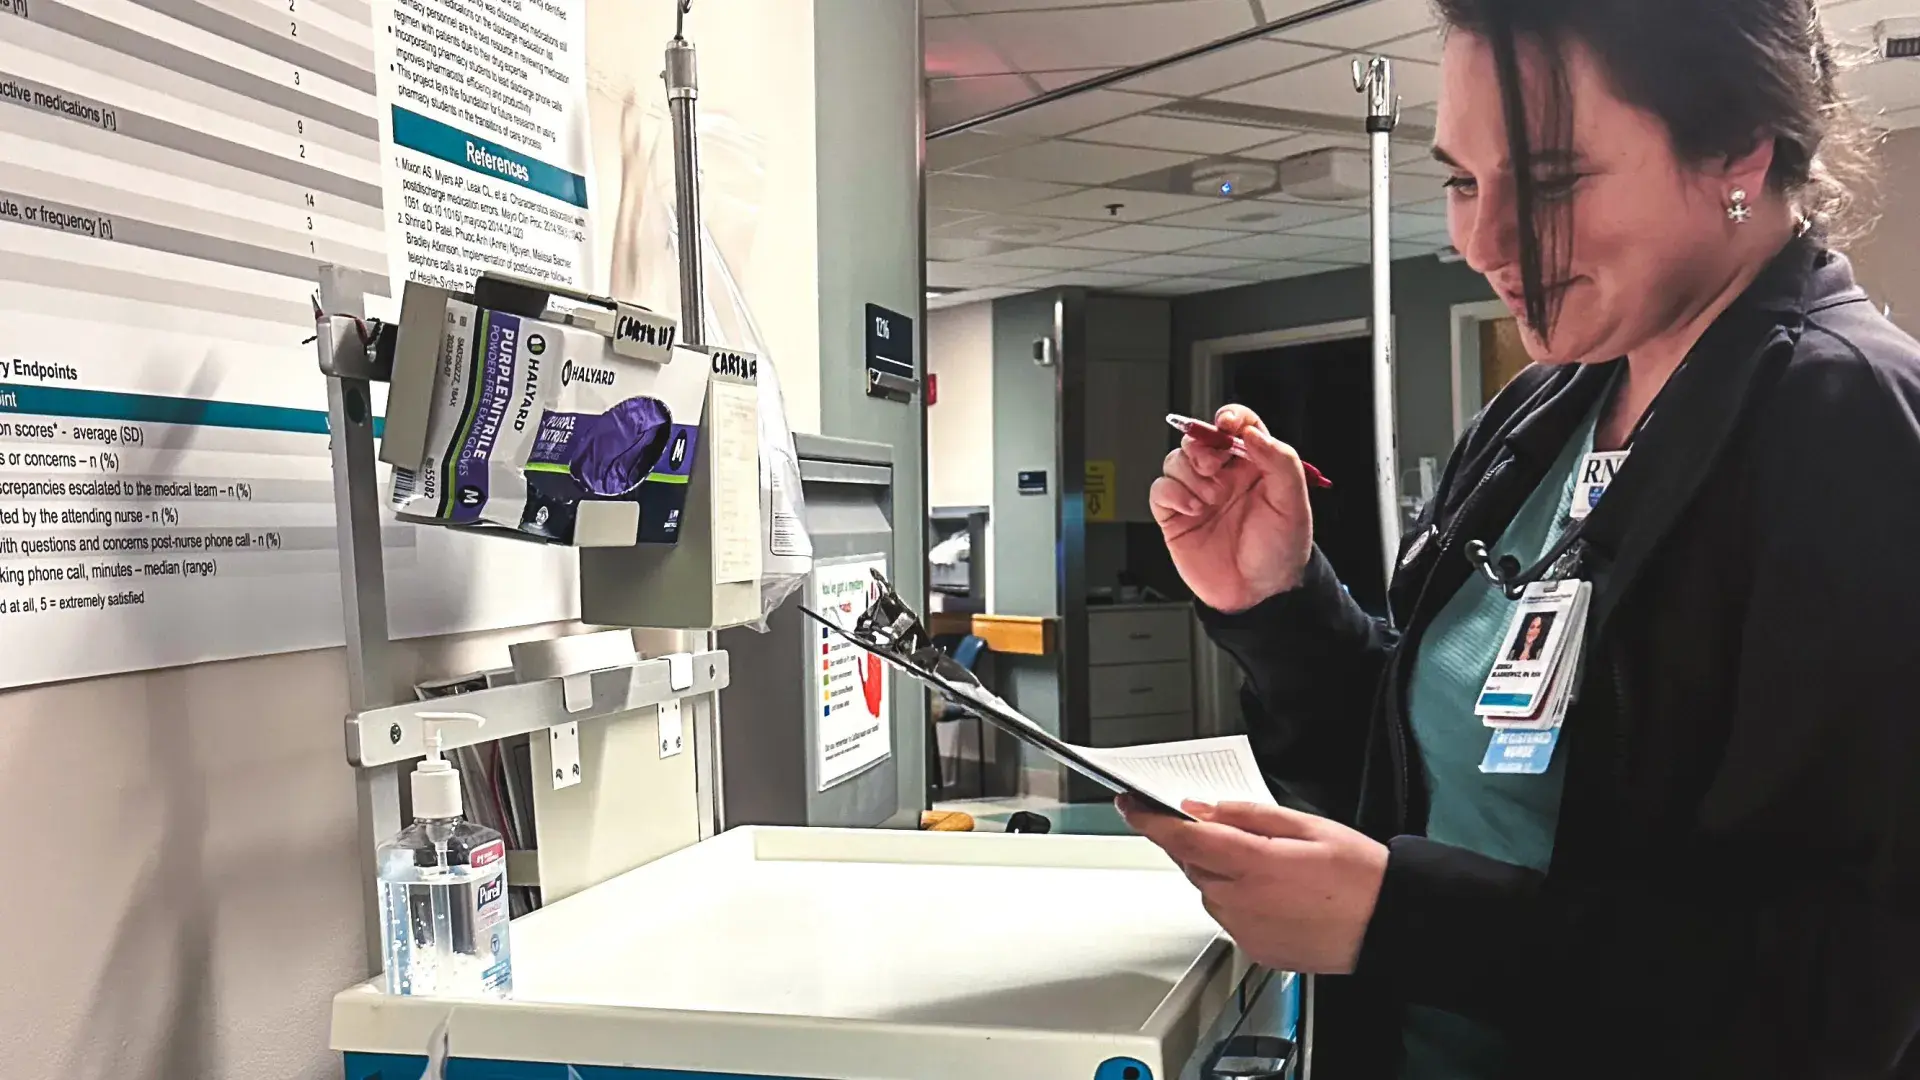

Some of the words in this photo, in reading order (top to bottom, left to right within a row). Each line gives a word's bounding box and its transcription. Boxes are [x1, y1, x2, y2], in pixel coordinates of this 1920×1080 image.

[289, 0, 295, 12] 2
[291, 23, 296, 36] 2
[394, 9, 420, 28] regimen
[421, 22, 435, 36] with
[436, 29, 460, 48] patients
[395, 26, 436, 58] Incorporating
[438, 46, 468, 70] pharmacy
[294, 72, 300, 85] 3
[397, 62, 412, 80] This
[412, 72, 435, 90] project
[435, 80, 448, 96] lays
[34, 92, 100, 122] medications
[103, 108, 116, 130] [n]
[398, 84, 430, 108] pharmacy
[430, 97, 458, 116] students
[464, 108, 474, 123] the
[298, 120, 303, 134] 9
[300, 144, 305, 158] 2
[466, 140, 530, 182] References
[435, 169, 454, 186] Myers
[466, 180, 481, 194] Leak
[305, 192, 315, 207] 14
[402, 178, 446, 203] postdischarge
[500, 207, 517, 222] Mayo
[25, 206, 37, 220] or
[40, 206, 96, 235] frequency
[99, 218, 113, 239] [n]
[307, 218, 313, 230] 3
[310, 241, 314, 254] 1
[406, 232, 430, 252] Bradley
[462, 246, 506, 266] Implementation
[408, 251, 439, 269] telephone
[616, 316, 647, 342] CART
[14, 359, 78, 381] Endpoints
[482, 324, 500, 406] POWDER-FREE
[496, 328, 514, 396] PURPLE
[712, 352, 740, 377] CART
[572, 366, 615, 386] HALYARD
[514, 358, 540, 431] HALYARD
[472, 407, 488, 435] EXAM
[474, 396, 506, 460] NITRILE
[546, 416, 576, 430] PURPLE
[73, 427, 118, 444] average
[120, 426, 144, 446] (SD)
[542, 429, 572, 443] NITRILE
[8, 453, 20, 466] or
[24, 454, 76, 468] concerns
[90, 456, 96, 468] n
[100, 453, 119, 472] (%)
[458, 436, 476, 476] GLOVES
[672, 439, 686, 462] M
[1582, 459, 1621, 484] RN
[69, 480, 121, 496] escalated
[124, 481, 134, 495] to
[136, 481, 152, 496] the
[154, 482, 192, 497] medical
[194, 483, 218, 497] team
[228, 486, 234, 496] n
[236, 483, 252, 501] (%)
[424, 469, 434, 500] 55082
[464, 489, 478, 504] M
[22, 508, 36, 528] by
[40, 508, 58, 524] the
[61, 508, 112, 526] attending
[115, 510, 143, 523] nurse
[152, 511, 158, 522] n
[162, 508, 178, 527] (%)
[21, 536, 76, 556] questions
[80, 536, 100, 551] and
[103, 537, 149, 550] concerns
[152, 534, 202, 552] post-nurse
[204, 533, 234, 550] phone
[236, 532, 250, 547] call
[258, 536, 264, 547] n
[266, 532, 281, 550] (%)
[28, 565, 64, 586] phone
[66, 564, 89, 581] call,
[92, 562, 132, 579] minutes
[144, 560, 180, 578] median
[183, 558, 216, 578] (range)
[10, 600, 20, 613] at
[22, 598, 38, 613] all,
[40, 596, 46, 610] 5
[60, 594, 106, 610] extremely
[108, 590, 144, 606] satisfied
